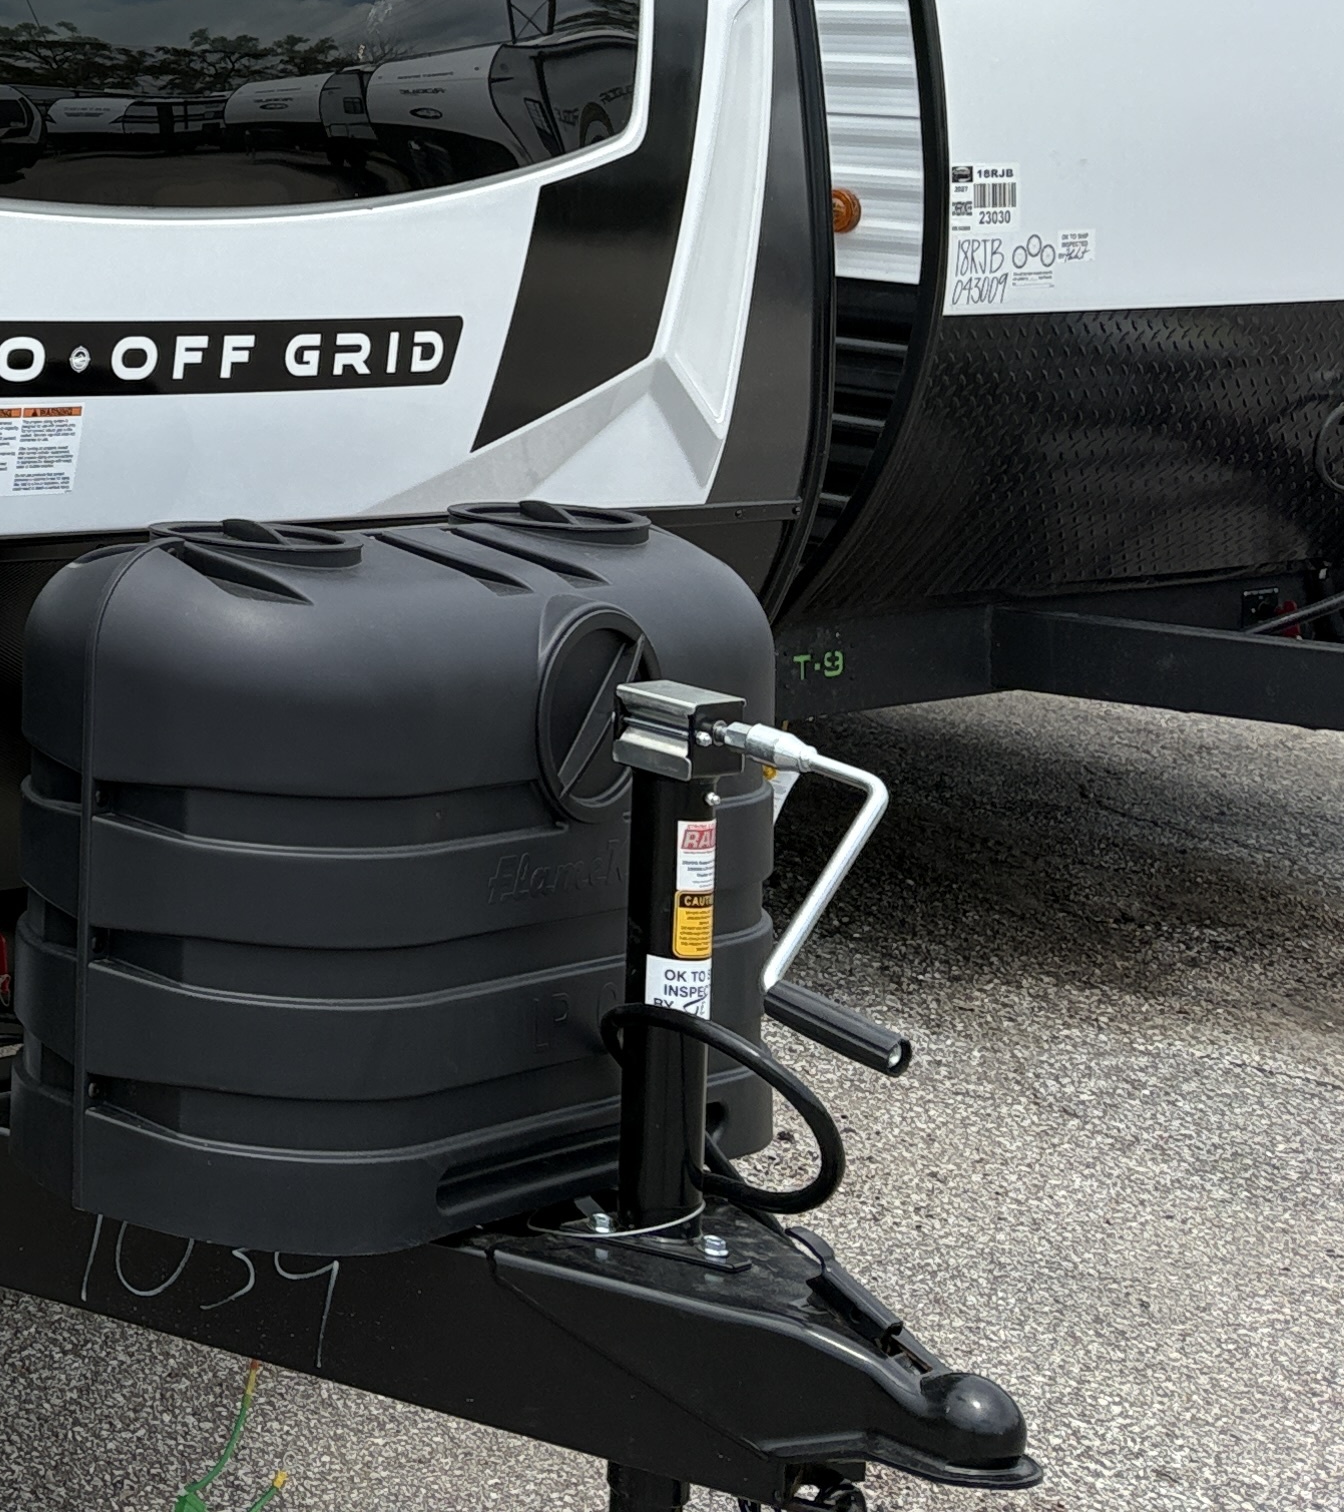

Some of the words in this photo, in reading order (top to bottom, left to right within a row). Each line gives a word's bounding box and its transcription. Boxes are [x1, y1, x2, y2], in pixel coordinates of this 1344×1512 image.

[977, 169, 1014, 179] 18RJB
[979, 210, 1011, 225] 23030
[955, 238, 1005, 278] 18RJB
[951, 272, 1009, 306] 043009
[111, 334, 256, 381] OFF
[284, 330, 444, 377] GRID
[682, 830, 716, 850] RA
[684, 895, 713, 908] CAUT
[664, 969, 687, 983] OK
[691, 969, 705, 983] TO
[664, 983, 708, 999] INSPEC
